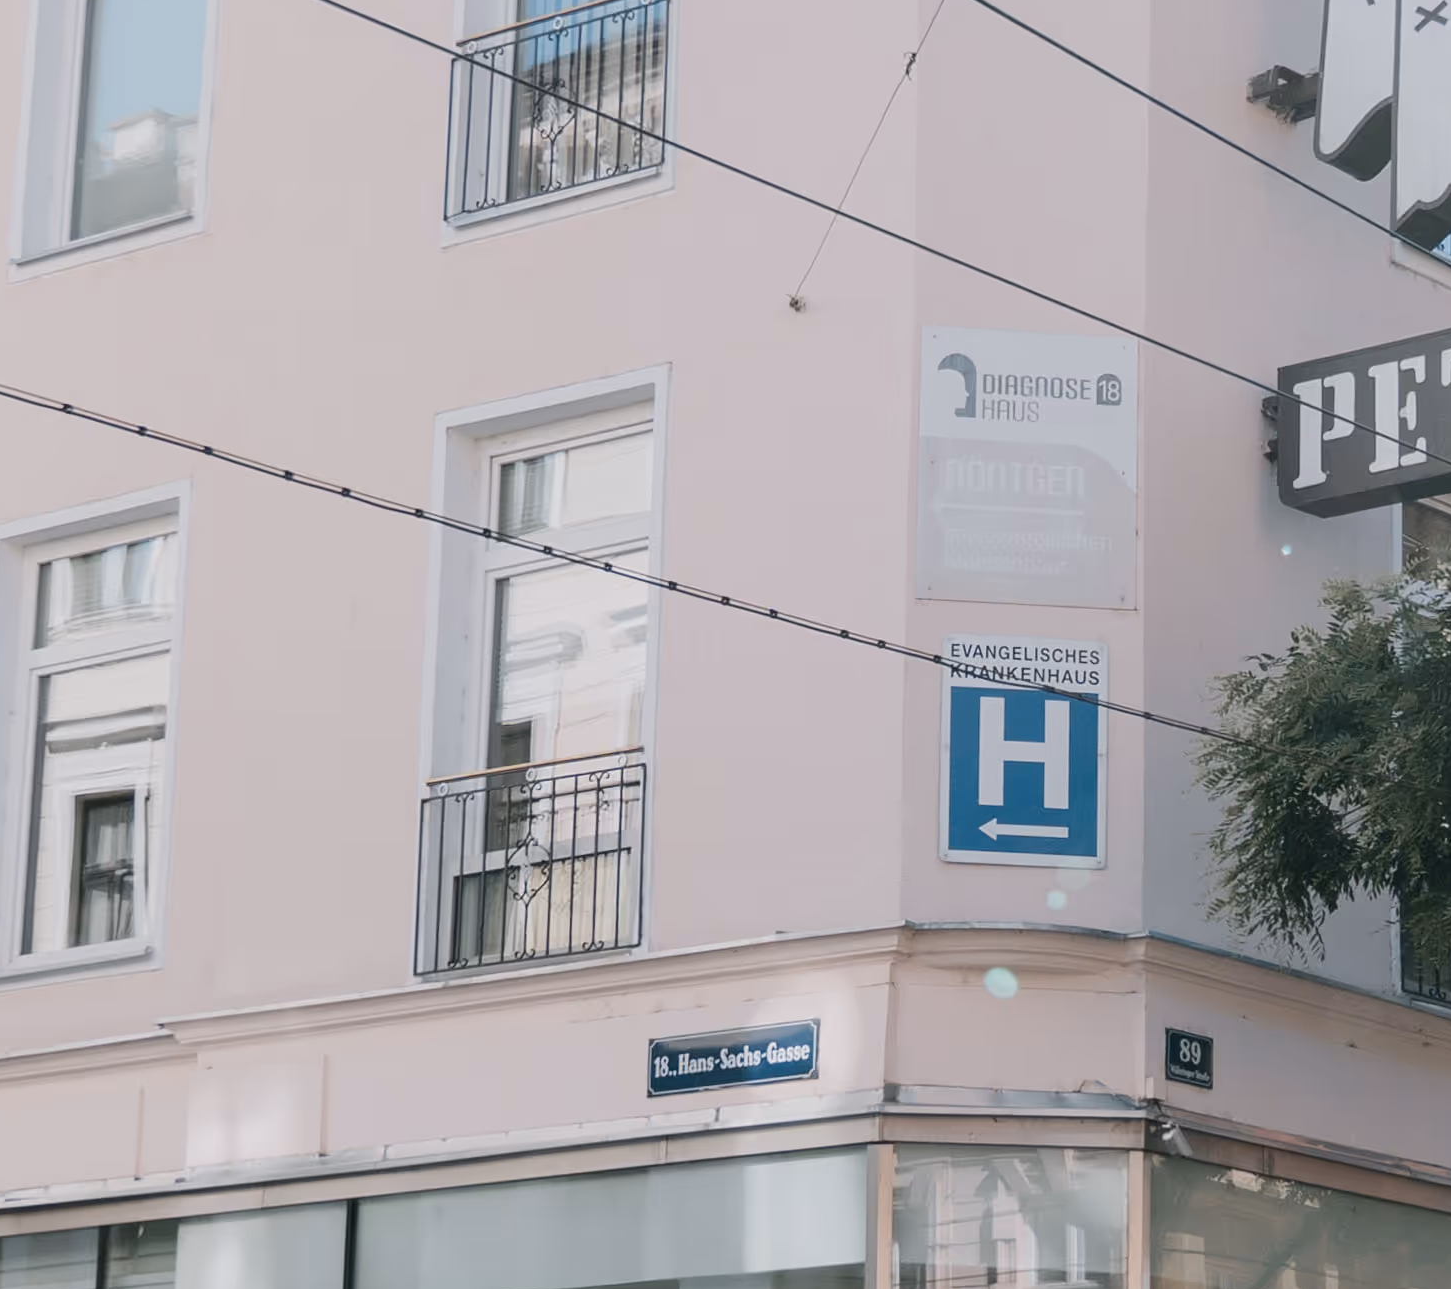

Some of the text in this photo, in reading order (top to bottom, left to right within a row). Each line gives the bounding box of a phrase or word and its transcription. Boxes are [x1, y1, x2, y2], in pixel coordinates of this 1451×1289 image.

[982, 374, 1121, 402] DIAGNOSE 18
[982, 398, 1039, 422] HAUS
[950, 643, 1100, 665] EVANGELISCHES
[949, 664, 1100, 685] KRANKENHAUS
[978, 696, 1070, 809] H
[678, 1042, 811, 1075] Hans-Sachs-Gasse
[1179, 1038, 1202, 1065] 89
